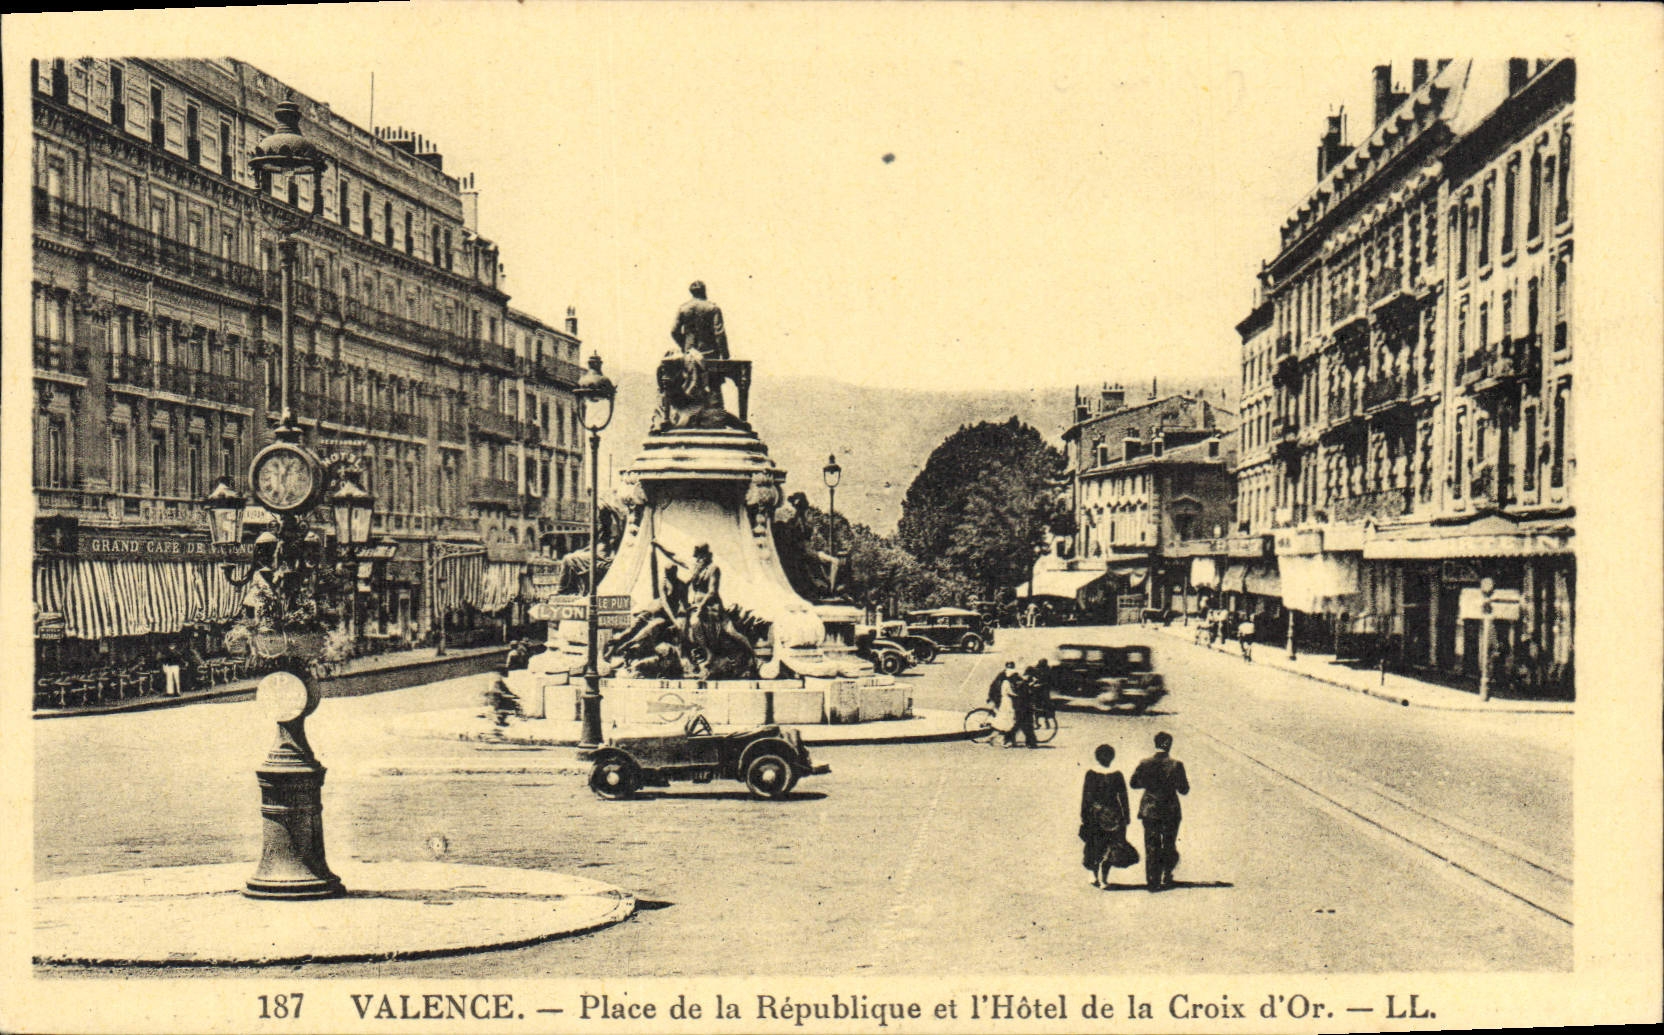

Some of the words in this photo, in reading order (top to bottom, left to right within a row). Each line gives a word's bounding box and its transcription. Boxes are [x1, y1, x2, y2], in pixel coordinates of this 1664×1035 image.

[92, 539, 140, 553] GRAND
[186, 541, 205, 554] DE
[598, 597, 609, 609] LE
[611, 597, 630, 609] PUY
[540, 605, 585, 620] LYON
